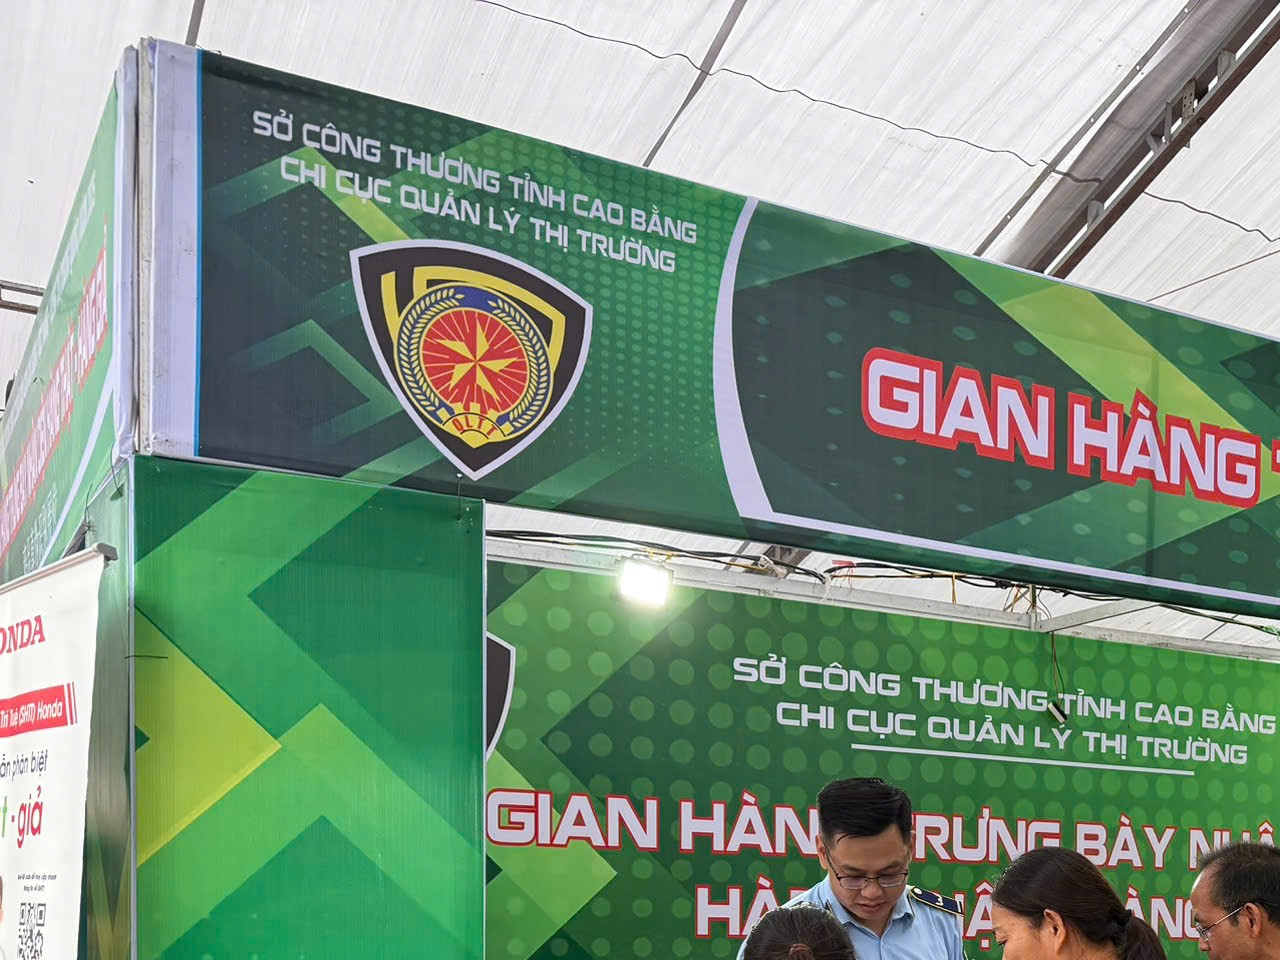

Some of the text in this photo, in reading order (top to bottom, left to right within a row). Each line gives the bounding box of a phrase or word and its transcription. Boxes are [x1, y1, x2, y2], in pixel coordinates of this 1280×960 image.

[253, 109, 697, 244] SỞ CÔNG THƯƠNG TỈNH CAO BẰNG
[280, 156, 676, 273] CHI CỤC QUẢN LÝ THỊ TRƯỜNG
[866, 356, 1050, 460] GIAN
[1072, 401, 1257, 500] HÀNG
[37, 698, 63, 720] Honda
[733, 653, 1276, 736] SỞ CÔNG THƯƠNG TỈNH CAO BẰNG
[776, 702, 1248, 766] CHI CỤC QUẢN LÝ THỊ TRƯỜNG
[31, 749, 48, 777] biệt
[17, 784, 43, 848] giả
[486, 790, 659, 851] GIAN
[680, 791, 819, 855] HÀN
[912, 807, 1061, 863] RƯNG
[1076, 813, 1177, 869] BÀY
